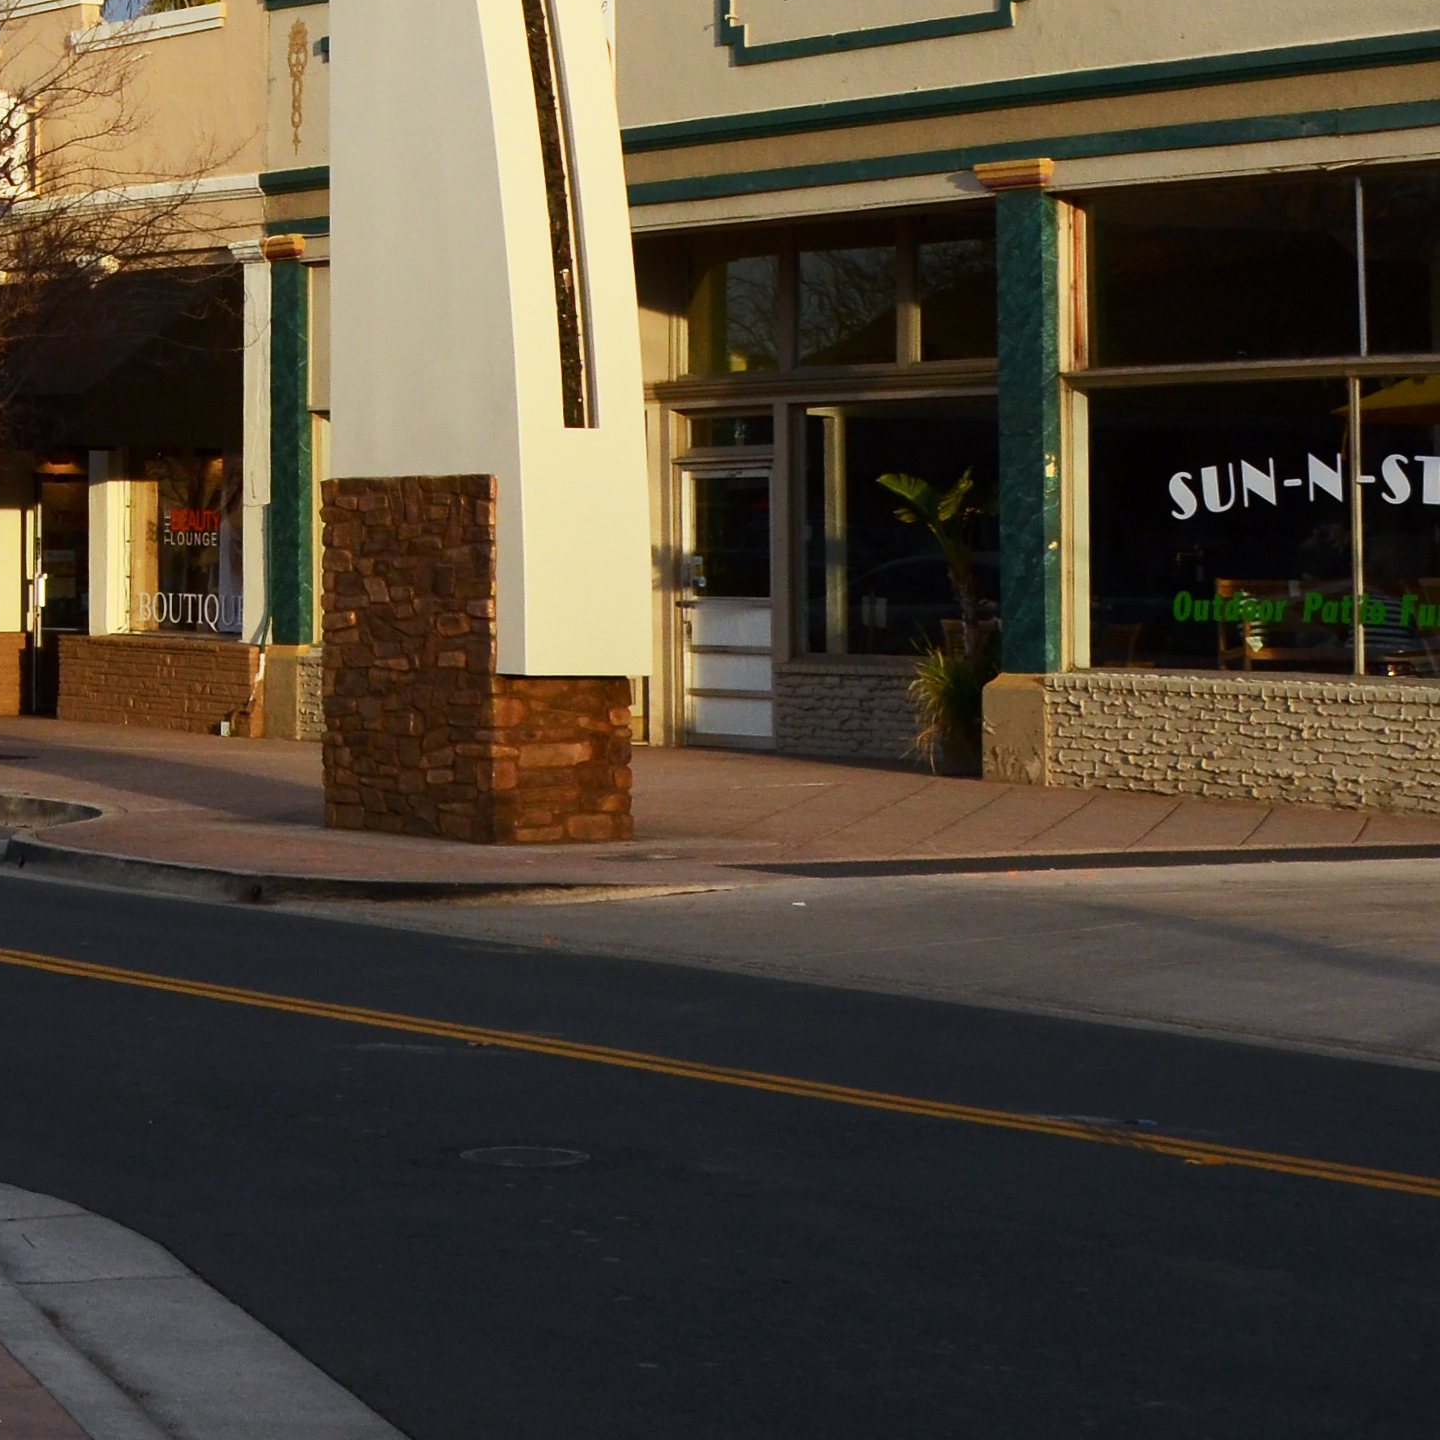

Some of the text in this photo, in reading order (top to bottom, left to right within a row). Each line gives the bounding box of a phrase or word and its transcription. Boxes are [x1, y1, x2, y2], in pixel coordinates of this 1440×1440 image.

[1168, 452, 1440, 520] SUN-N-ST
[171, 508, 220, 532] BEAUTY
[170, 532, 218, 546] LOUNGE
[140, 592, 243, 633] BOUTIQU
[1173, 590, 1288, 623] Outdoor
